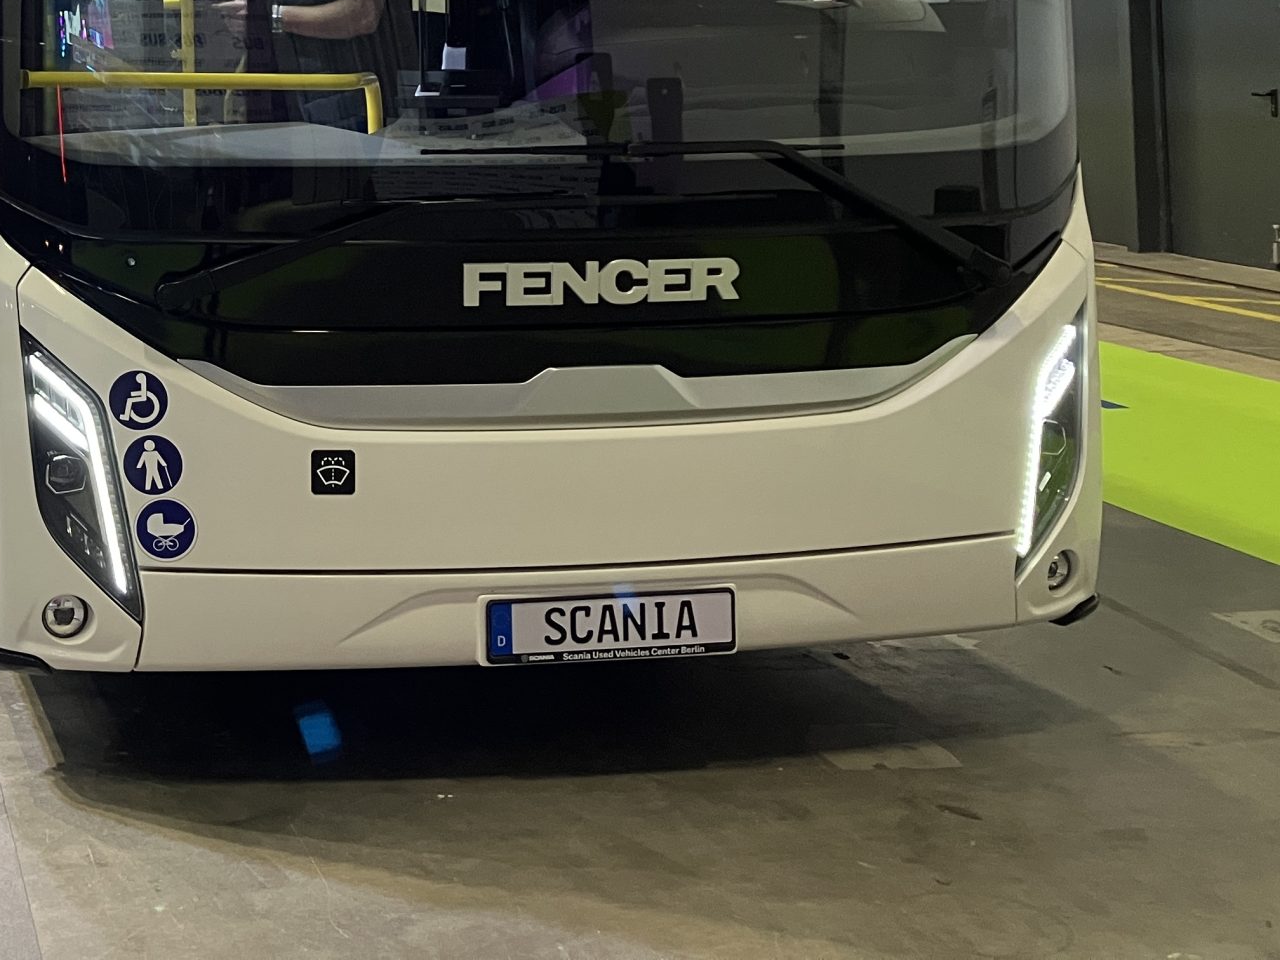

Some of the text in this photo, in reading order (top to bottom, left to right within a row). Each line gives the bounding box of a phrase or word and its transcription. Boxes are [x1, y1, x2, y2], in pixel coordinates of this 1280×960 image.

[462, 256, 741, 307] FENCER
[543, 599, 699, 646] SCANIA
[497, 635, 507, 647] D
[562, 645, 706, 661] Scania Used Vehicles Center Berlin
